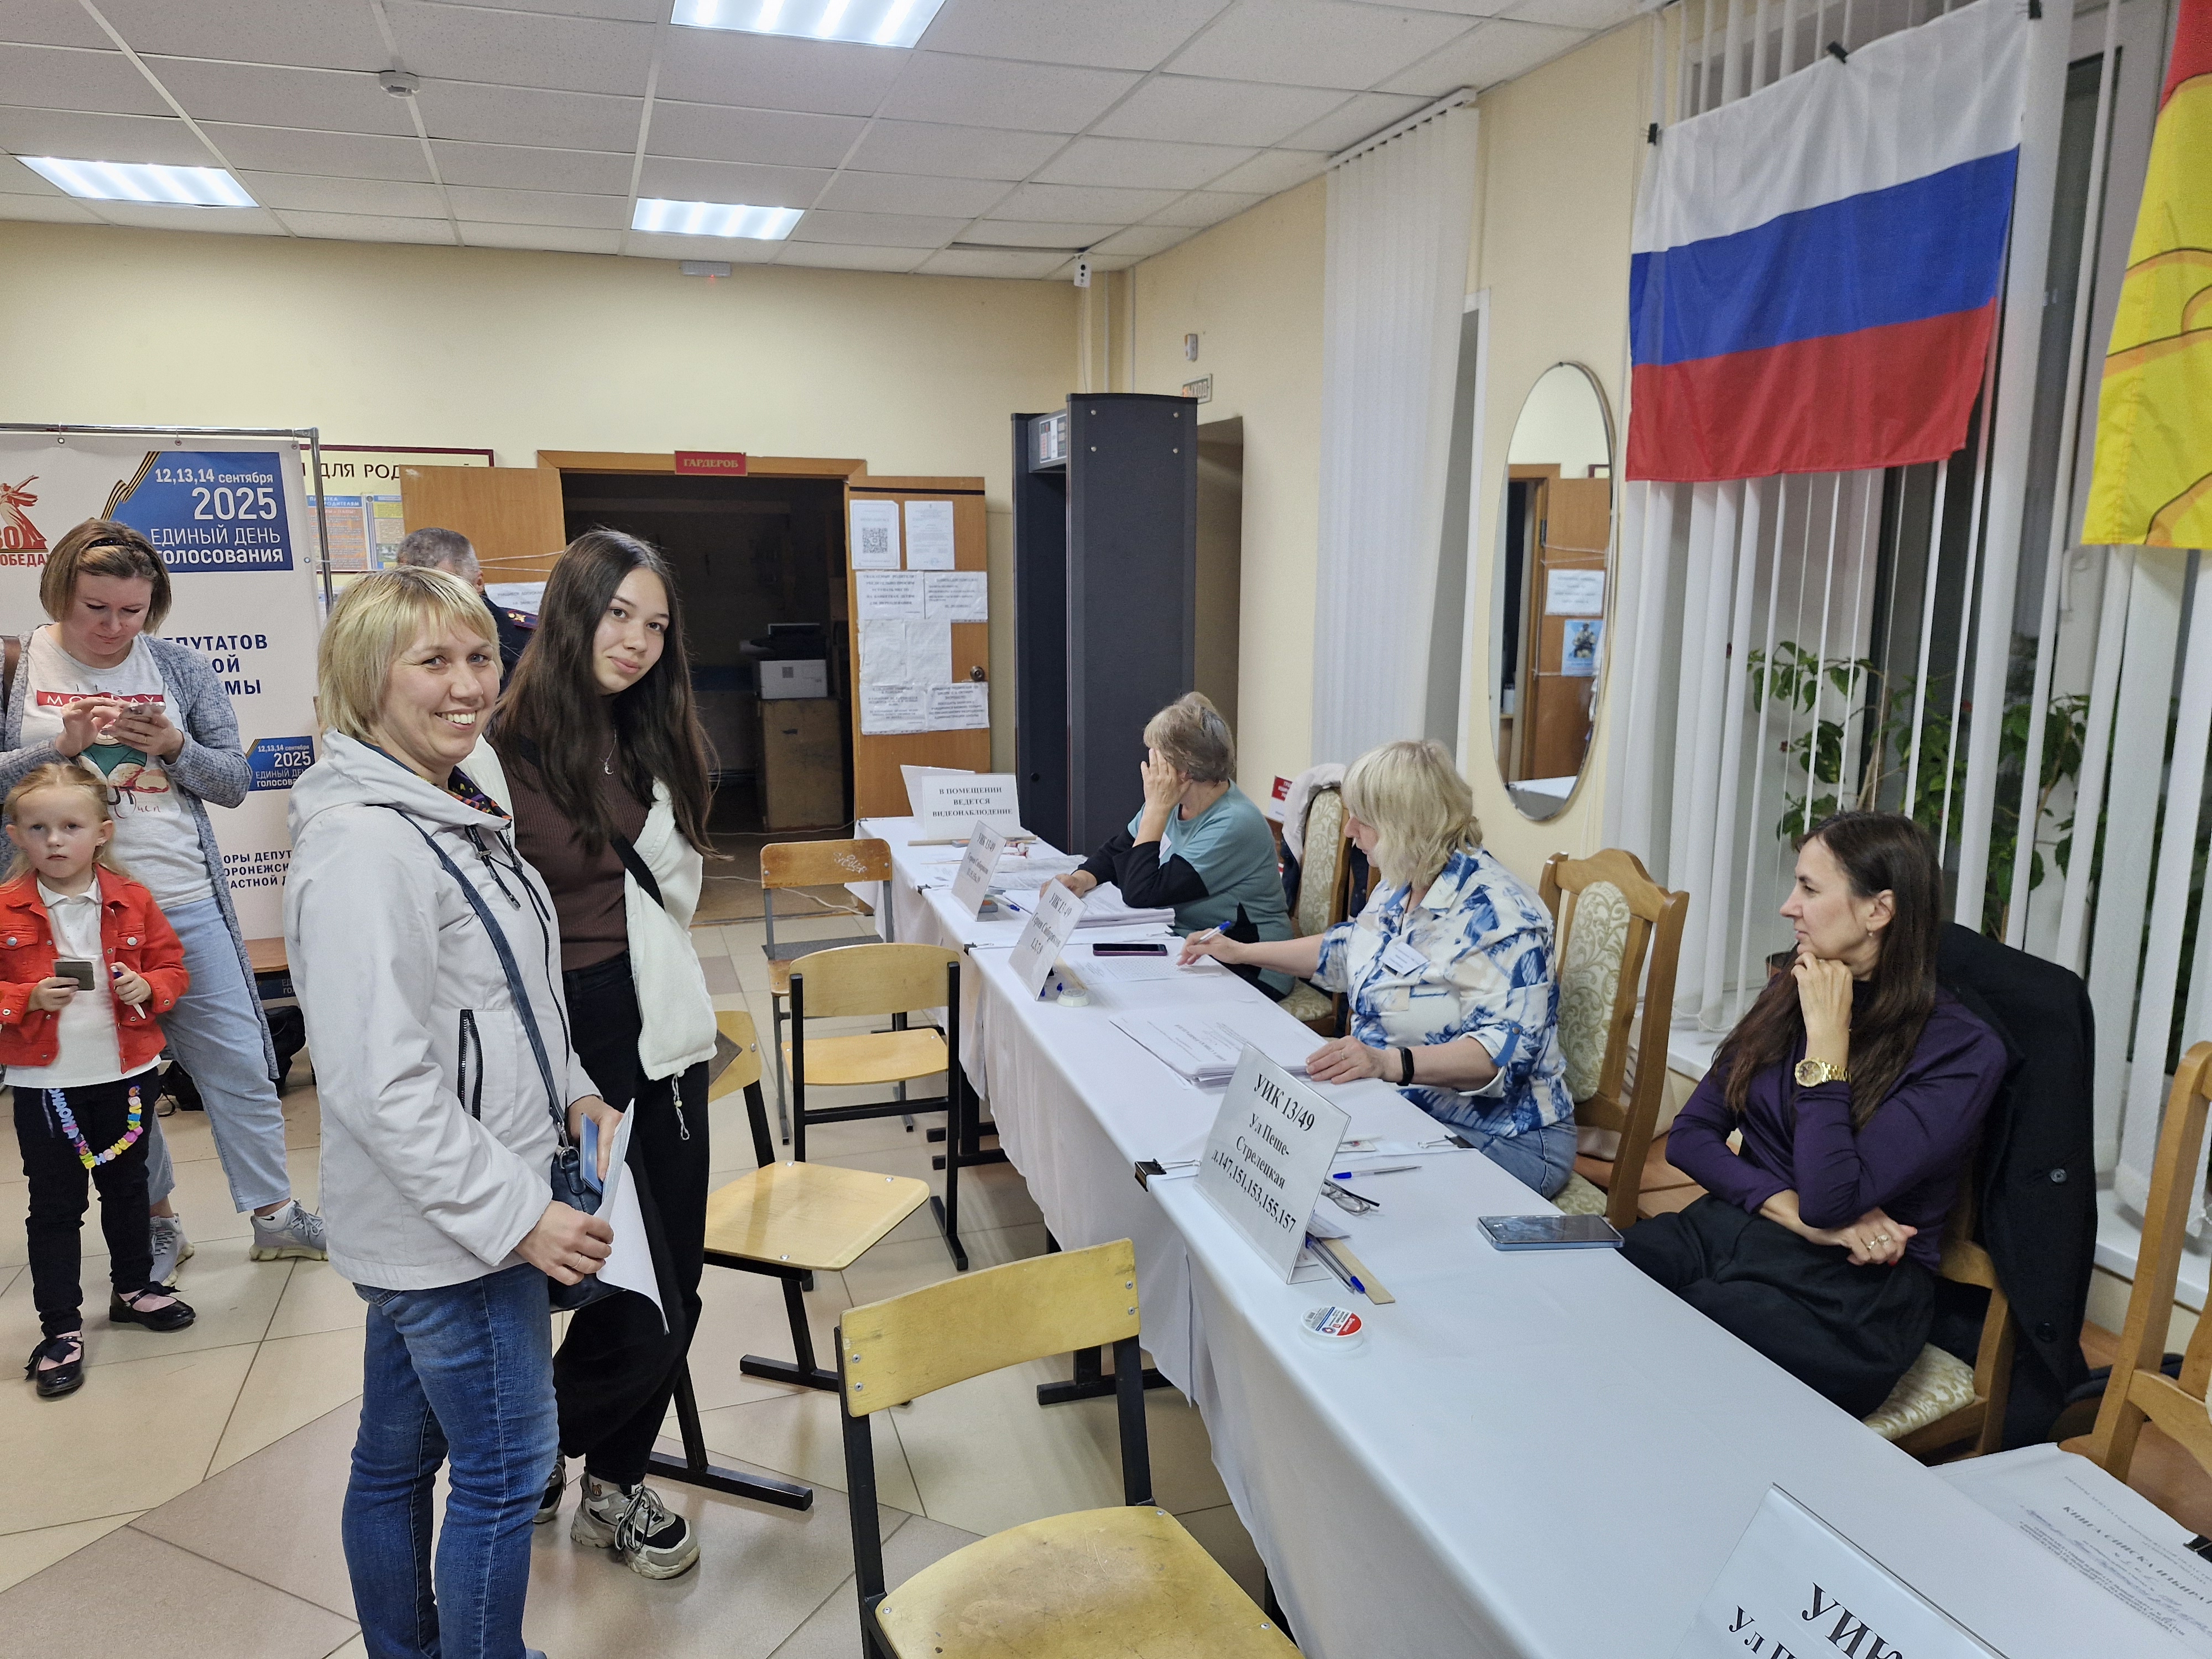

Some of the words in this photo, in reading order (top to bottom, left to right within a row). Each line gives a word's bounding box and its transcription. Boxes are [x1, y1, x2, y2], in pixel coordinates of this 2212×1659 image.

[684, 458, 739, 468] ГАРДЕРОБ
[155, 468, 215, 485] 12,13,14
[218, 472, 273, 486] сентября
[191, 487, 277, 520] 2025
[150, 524, 228, 547] ЕДИНЫЙ
[234, 527, 281, 546] ДЕНЬ
[156, 548, 284, 565] олосования
[258, 744, 284, 753] 12,13,14
[273, 751, 311, 768] 2025
[255, 768, 289, 780] ЕДИНЫЙ
[932, 808, 1013, 817] ВИДЕОНАБЛЮДЕНИЕ
[227, 874, 278, 889] АСТНОЙ
[1049, 893, 1062, 910] УИК
[1032, 912, 1044, 929] Героев
[1041, 922, 1061, 947] Сибиряков
[1254, 1073, 1284, 1109] УИК
[1281, 1097, 1315, 1131] 13/49
[1249, 1112, 1262, 1134] Ул
[1261, 1124, 1290, 1156] Пеше-
[1236, 1135, 1286, 1190] Стрелецкая
[1211, 1149, 1297, 1233] д.147,151,153,155,157
[1729, 1605, 1766, 1655] Ул
